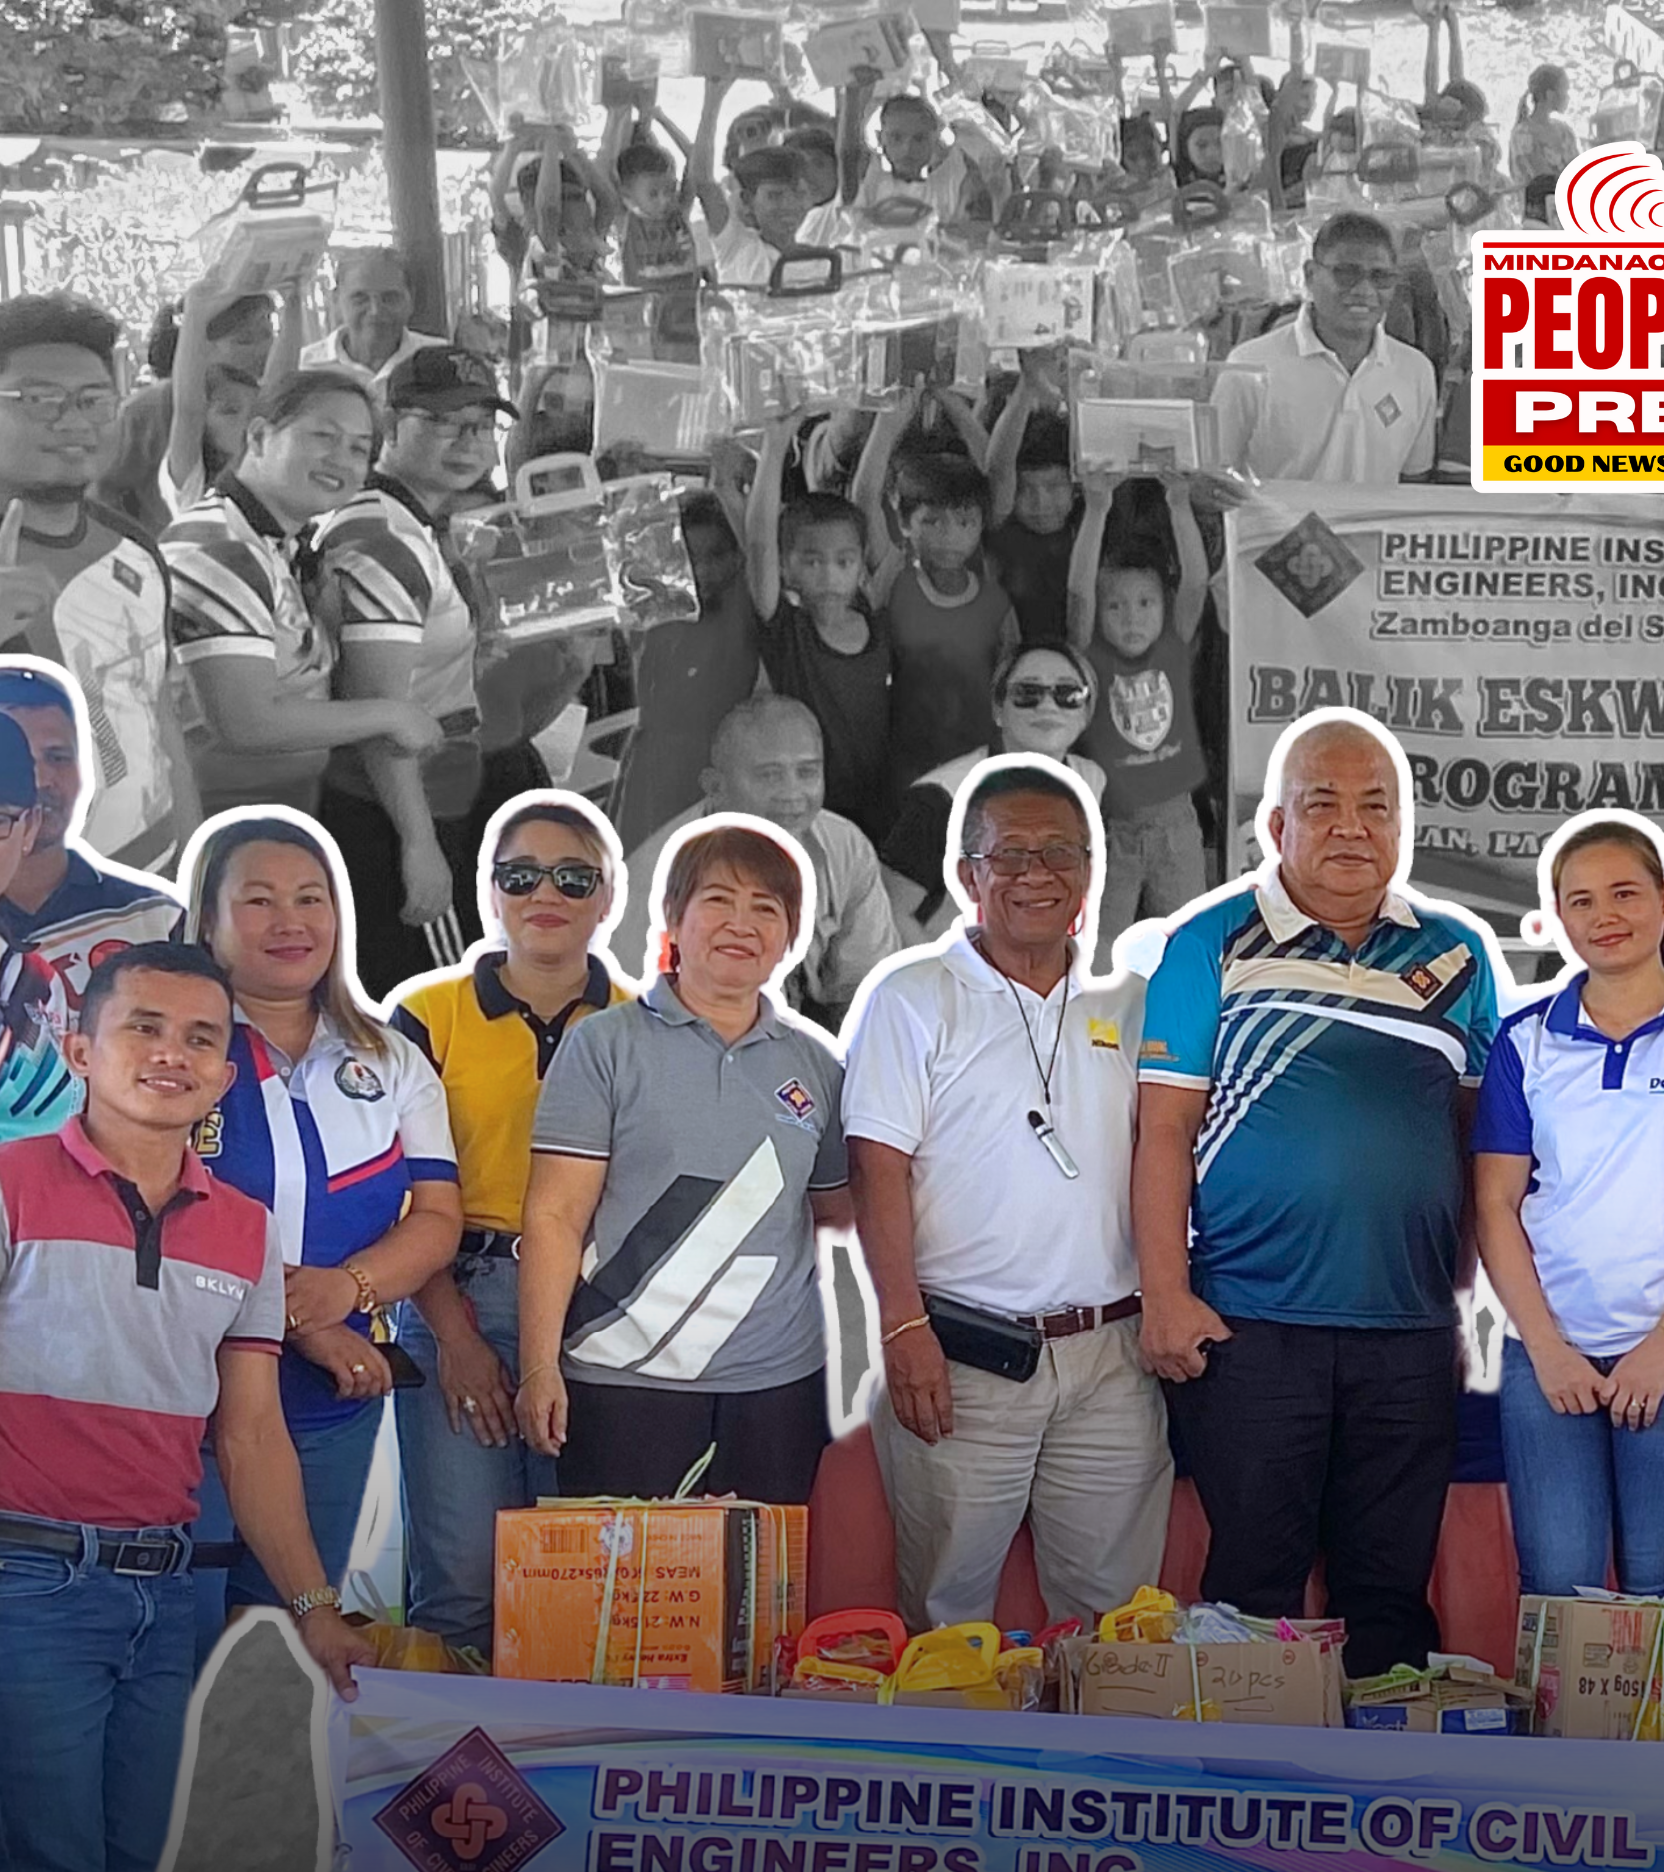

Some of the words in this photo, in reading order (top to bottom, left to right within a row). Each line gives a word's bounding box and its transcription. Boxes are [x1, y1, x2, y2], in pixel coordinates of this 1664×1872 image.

[1384, 533, 1590, 561] PHILIPPINE
[1383, 570, 1604, 603] ENGINEERS,
[1376, 611, 1571, 642] Zamboanga
[1583, 614, 1632, 638] del
[1250, 666, 1464, 734] BALIK
[658, 1653, 688, 1663] Extra
[1579, 1677, 1595, 1695] 48
[1600, 1679, 1608, 1696] X
[398, 1753, 473, 1821] PHILIPPINE
[476, 1756, 540, 1824] INSTITUTE
[601, 1768, 975, 1828] PHILIPPINE
[999, 1786, 1348, 1844] INSTITUTE
[1369, 1804, 1455, 1849] OF
[1476, 1809, 1649, 1860] CIVIL
[405, 1830, 429, 1849] OF
